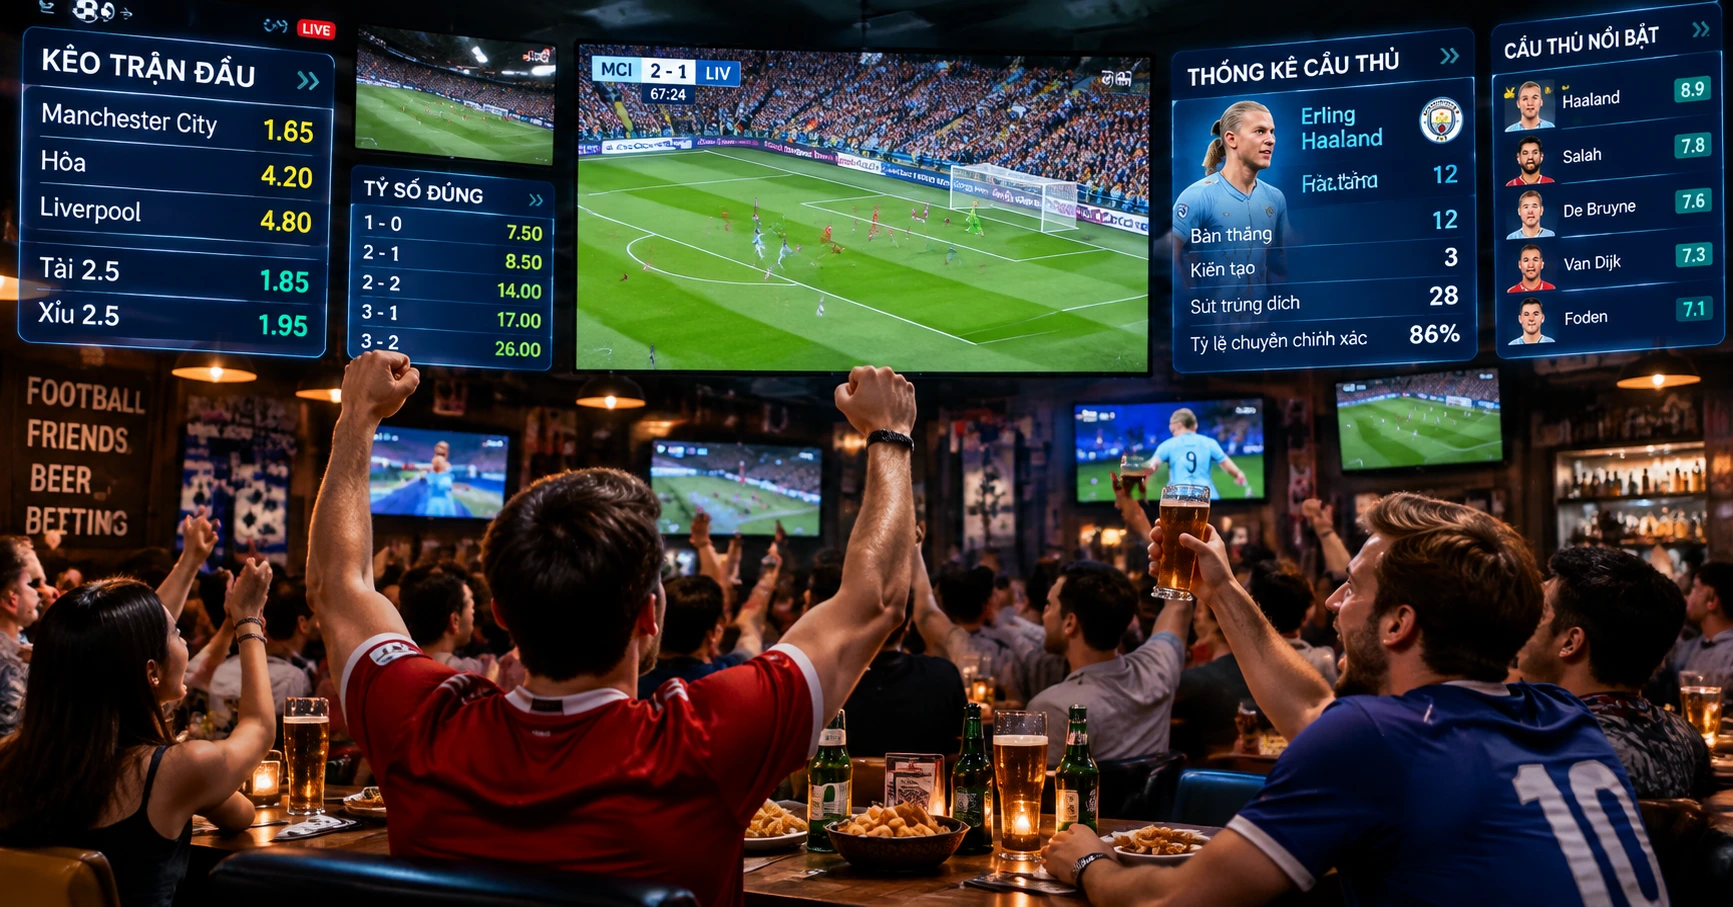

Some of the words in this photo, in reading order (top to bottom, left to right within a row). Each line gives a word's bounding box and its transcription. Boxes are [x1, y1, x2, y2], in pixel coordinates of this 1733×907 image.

[302, 22, 331, 37] LIVE
[109, 51, 186, 86] TRẬN
[193, 55, 255, 88] ĐẦU
[601, 61, 632, 77] MCI
[650, 62, 661, 79] 2
[678, 64, 687, 79] 1
[705, 66, 732, 81] LIV
[1270, 55, 1298, 80] KÊ
[650, 87, 687, 101] 67:24
[1562, 89, 1620, 109] Haaland
[1680, 80, 1705, 98] 8.9
[42, 102, 171, 131] Manchester
[176, 112, 218, 140] City
[263, 118, 314, 144] 1.65
[1301, 106, 1356, 127] Erling
[1302, 127, 1383, 151] Haaland
[1563, 147, 1602, 164] Salah
[1681, 136, 1705, 154] 7.8
[260, 164, 313, 189] 4.20
[1433, 164, 1458, 184] 12
[40, 195, 141, 225] Liverpool
[260, 209, 312, 234] 4.80
[1563, 204, 1583, 218] De
[1587, 201, 1637, 217] Bruyne
[1682, 192, 1705, 209] 7.6
[364, 214, 373, 230] 1
[390, 215, 402, 232] 0
[506, 224, 543, 242] 7.50
[1190, 228, 1222, 244] Bàn
[1432, 209, 1458, 230] 12
[363, 244, 374, 260] 2
[391, 245, 399, 262] 1
[505, 253, 543, 271] 8.50
[1444, 247, 1458, 267] 3
[1563, 257, 1591, 271] Van
[1595, 254, 1622, 272] Dijk
[1682, 246, 1706, 263] 7.3
[39, 256, 73, 279] Tài
[81, 259, 120, 282] 2.5
[260, 269, 309, 294] 1.85
[362, 274, 373, 290] 2
[389, 275, 401, 292] 2
[497, 282, 542, 300] 14.00
[1429, 285, 1459, 306] 28
[82, 303, 120, 327] 2.5
[259, 313, 308, 337] 1.95
[361, 303, 372, 320] 3
[389, 305, 397, 321] 1
[497, 311, 542, 329] 17.00
[1565, 310, 1608, 326] Foden
[1682, 300, 1705, 318] 7.1
[360, 333, 372, 349] 3
[388, 334, 399, 351] 2
[495, 340, 541, 358] 26.00
[1409, 323, 1461, 345] 86%
[26, 376, 145, 414] FOOTBALL
[27, 418, 128, 453] FRIENDS
[1185, 450, 1198, 474] 9
[30, 463, 92, 494] BEER
[1511, 758, 1671, 907] 10
